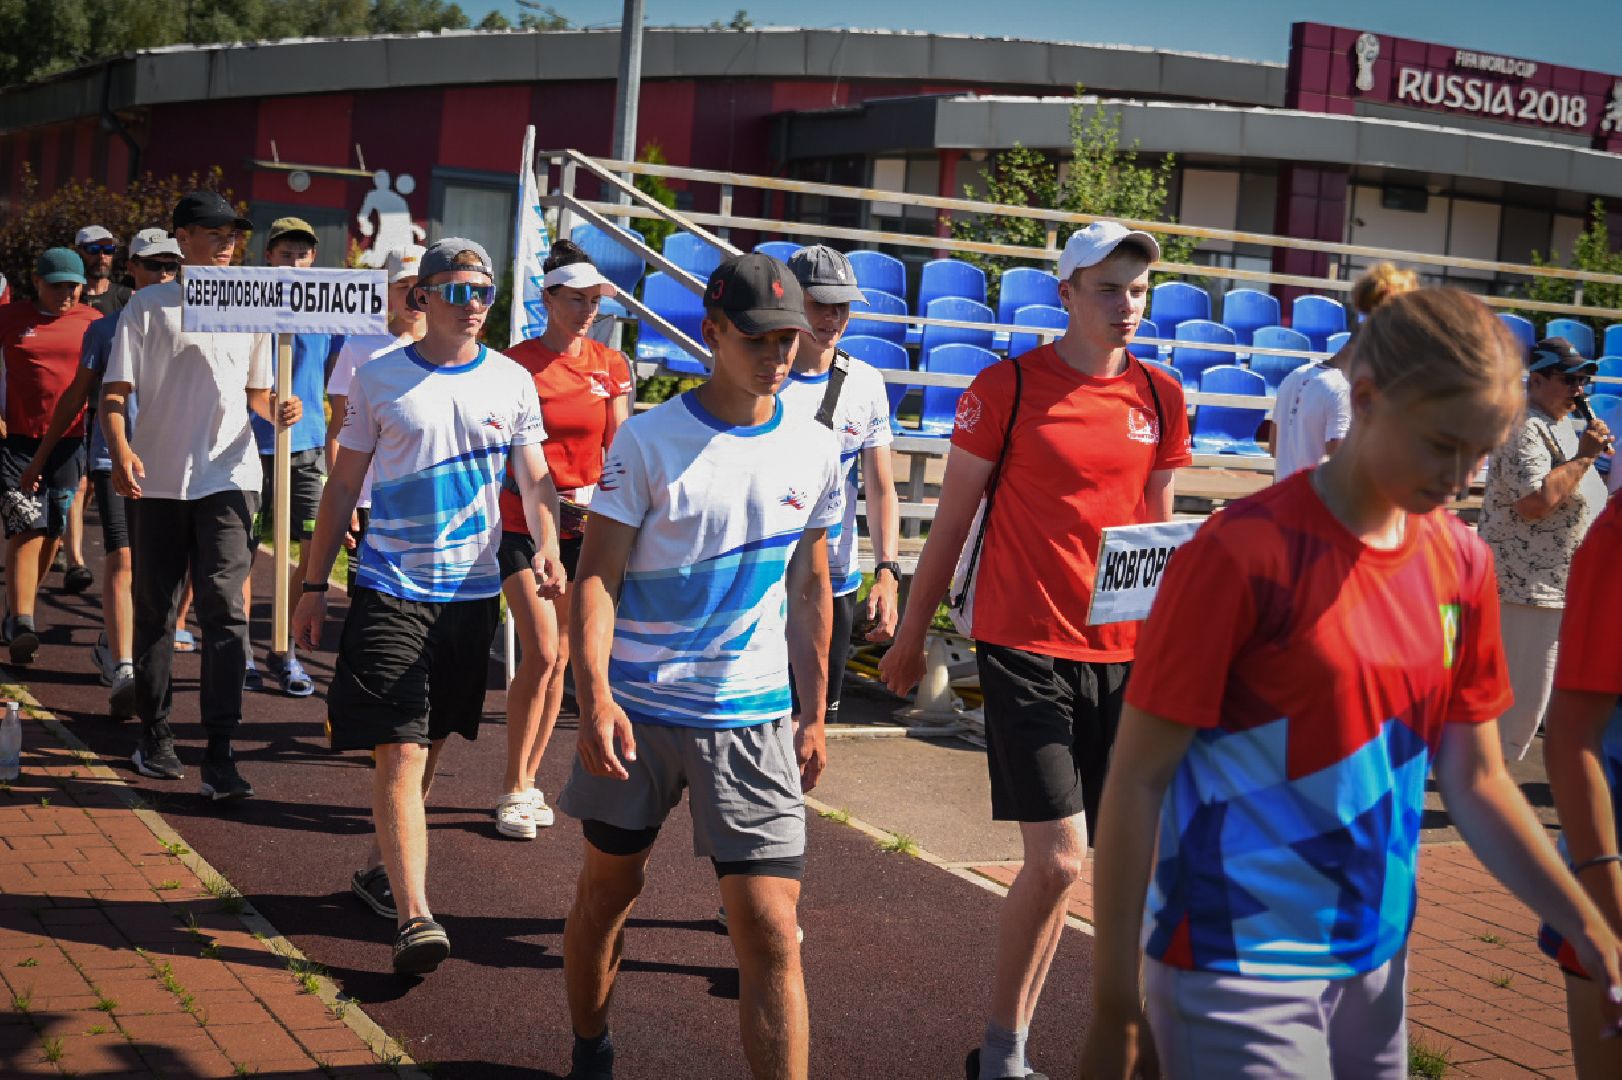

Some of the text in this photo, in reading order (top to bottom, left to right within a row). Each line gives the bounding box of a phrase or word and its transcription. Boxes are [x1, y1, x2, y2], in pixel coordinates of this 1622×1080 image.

[1397, 67, 1588, 128] RUSSIA 2018
[187, 279, 382, 315] СВЕРДЛОВСКАЯ ОБЛАСТЬ
